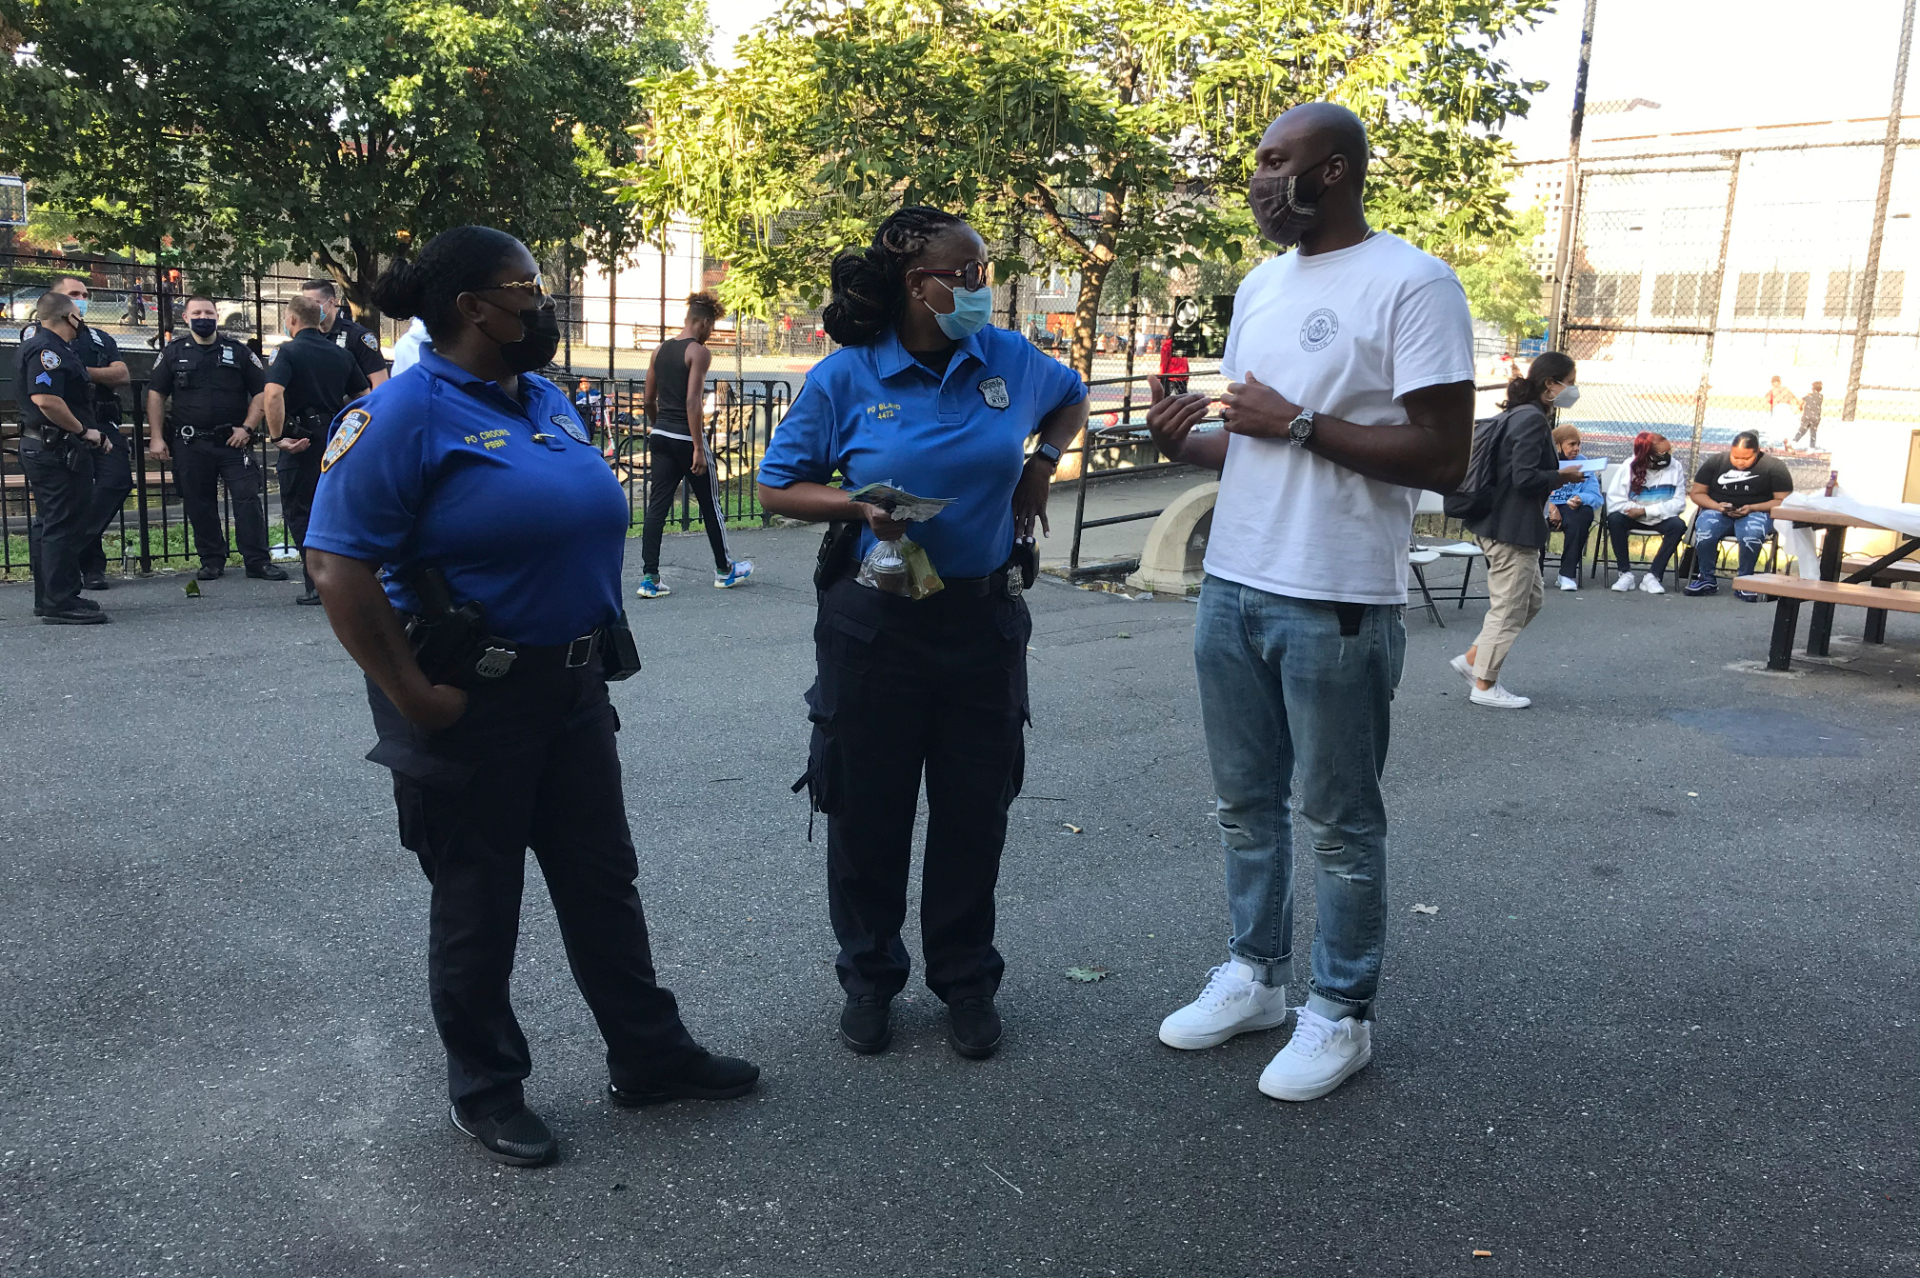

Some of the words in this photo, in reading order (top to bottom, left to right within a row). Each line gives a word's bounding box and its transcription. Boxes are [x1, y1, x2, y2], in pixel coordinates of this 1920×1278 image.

[866, 405, 876, 414] PO
[464, 434, 478, 444] PO
[479, 428, 511, 440] CROOKS
